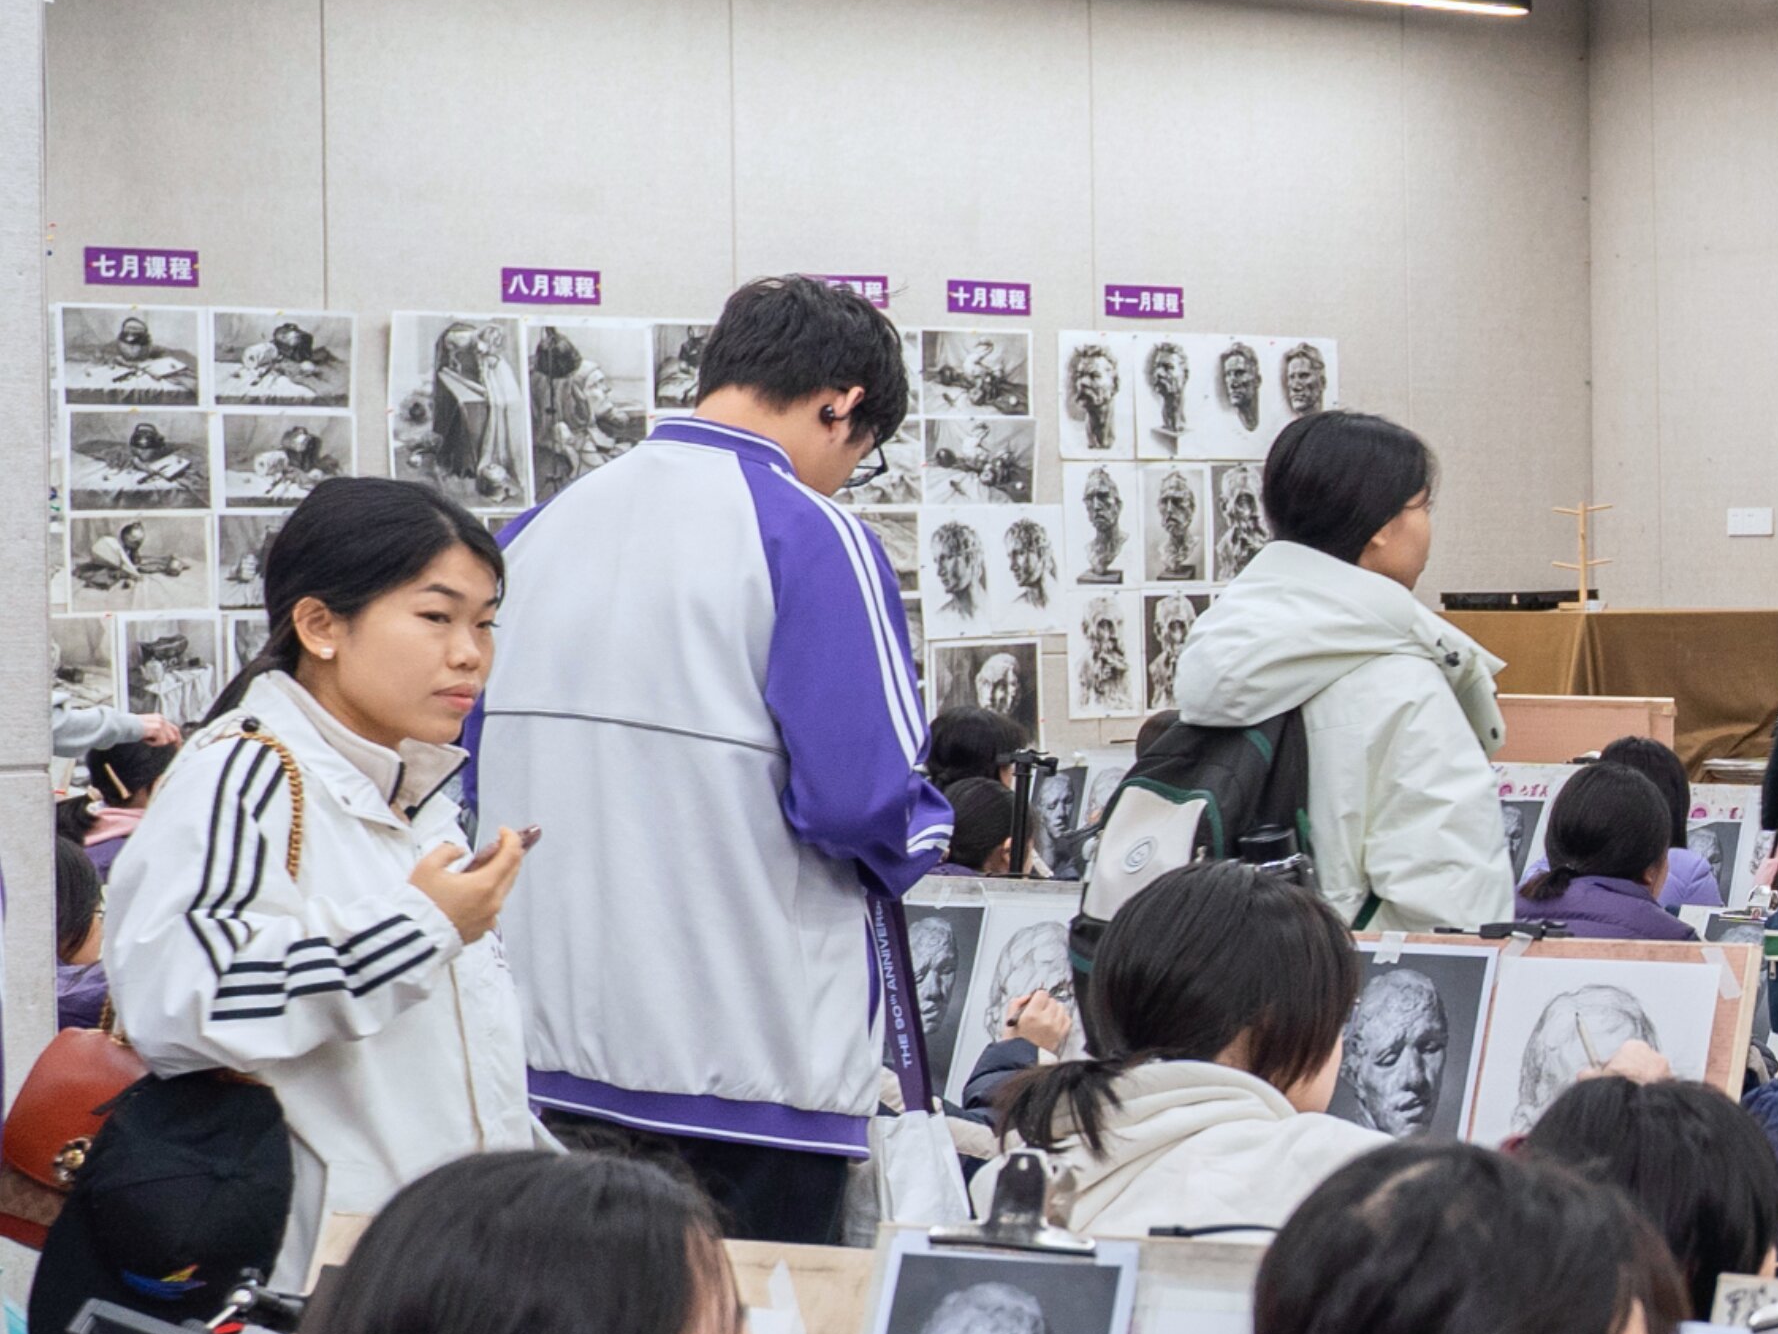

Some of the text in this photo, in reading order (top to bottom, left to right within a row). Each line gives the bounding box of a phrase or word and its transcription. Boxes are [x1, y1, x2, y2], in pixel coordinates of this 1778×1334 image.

[92, 253, 194, 282] 七月课程
[507, 273, 597, 300] 八月课程
[952, 285, 1027, 311] 十月课程
[1108, 290, 1180, 314] 十一月课程
[897, 1033, 912, 1069] THE
